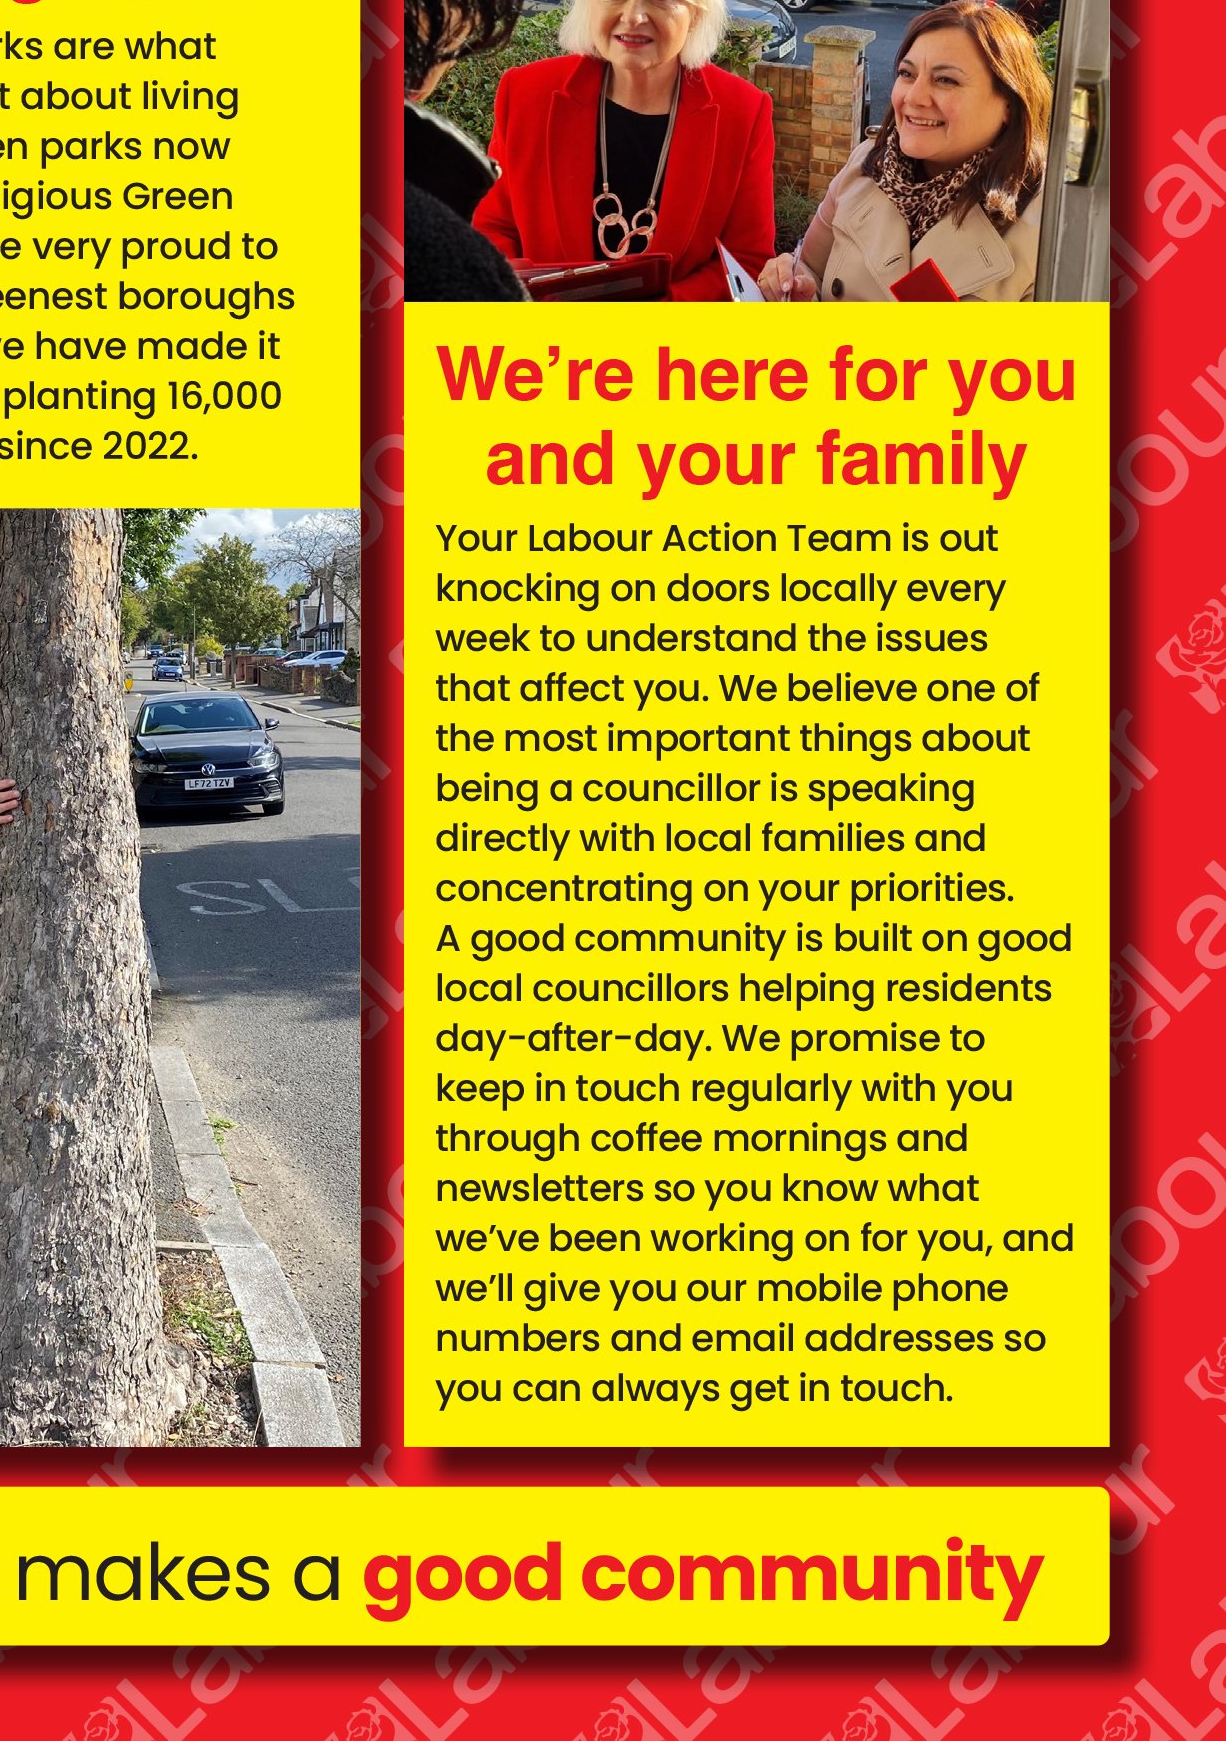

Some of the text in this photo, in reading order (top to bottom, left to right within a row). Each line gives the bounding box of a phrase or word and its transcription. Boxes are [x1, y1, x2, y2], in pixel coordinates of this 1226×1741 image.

[4, 380, 155, 420] planting
[168, 381, 281, 415] 16,000
[659, 347, 808, 401] here
[830, 345, 927, 401] for
[948, 359, 1074, 416] you
[104, 431, 198, 459] 2022.
[487, 429, 1027, 500] and your family
[188, 778, 230, 789] LF72 TZV
[436, 1022, 985, 1061] day-after-day. We promise to
[19, 1541, 270, 1601] makes
[294, 1556, 339, 1601] a
[364, 1542, 561, 1622] good
[582, 1537, 1045, 1621] community
